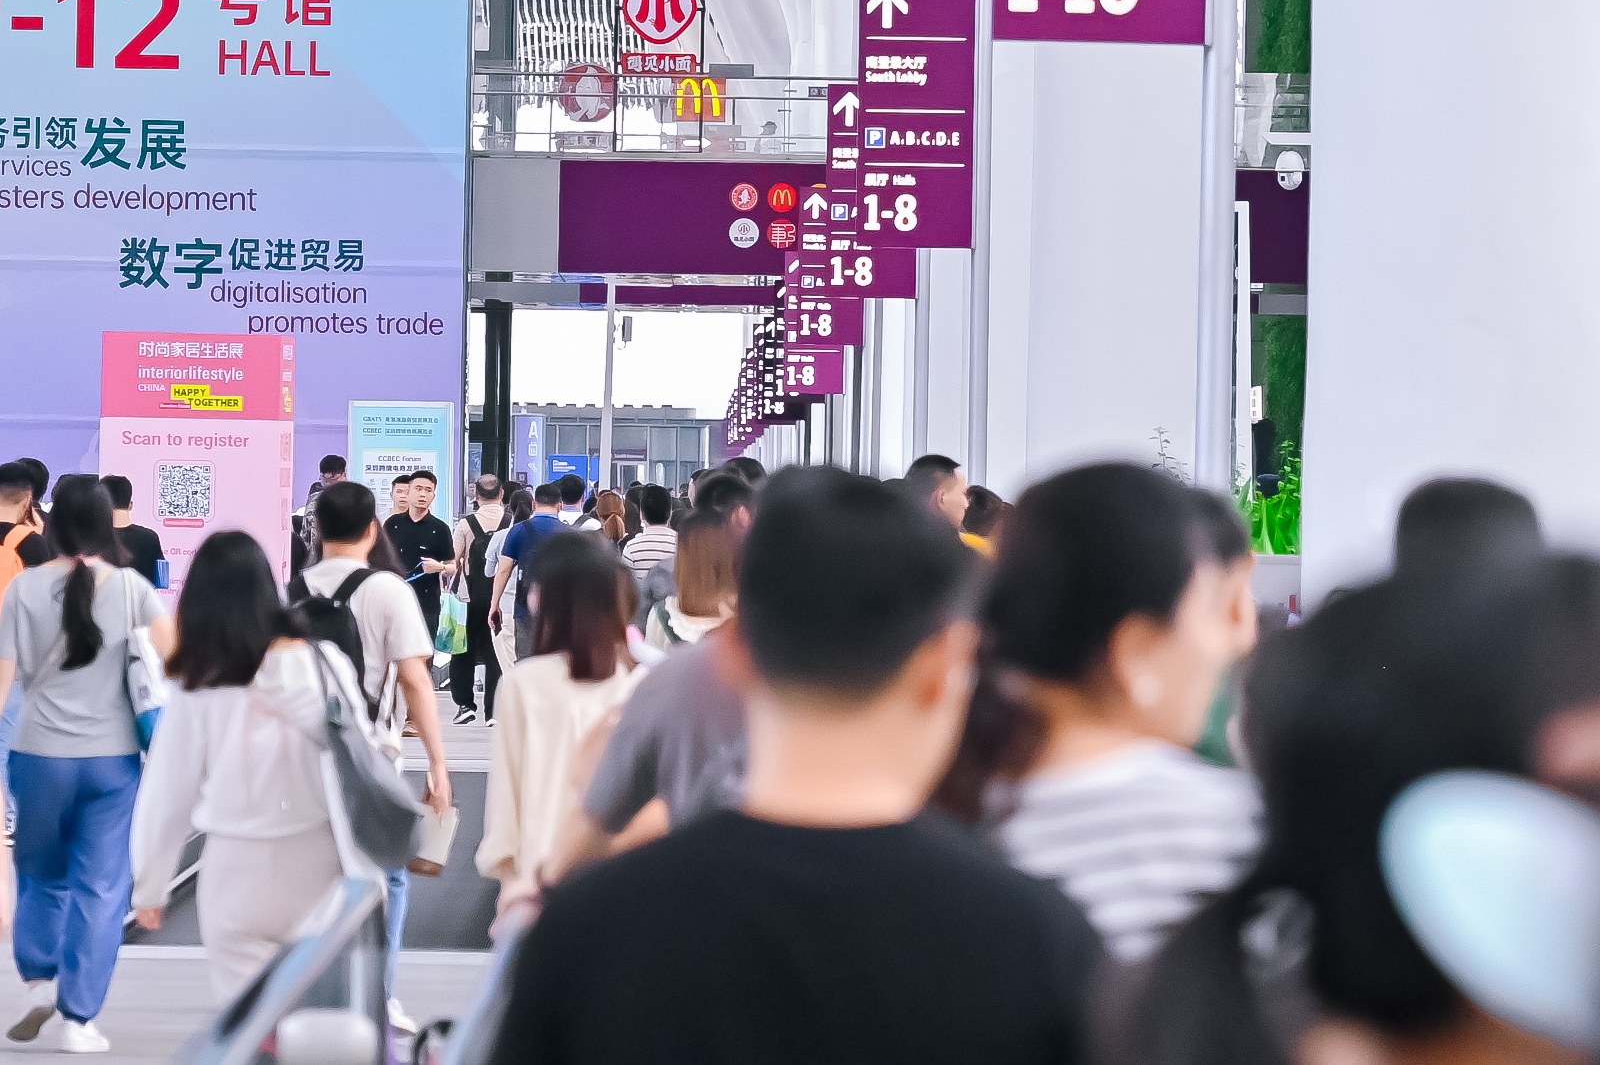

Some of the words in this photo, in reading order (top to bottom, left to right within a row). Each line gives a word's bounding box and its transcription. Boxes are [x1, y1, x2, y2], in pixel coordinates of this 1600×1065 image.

[218, 39, 332, 77] HALL
[72, 184, 258, 217] development
[863, 193, 918, 232] 1-8
[830, 256, 873, 286] 1-8
[210, 279, 368, 306] digitalisation
[247, 310, 368, 337] promotes
[375, 311, 445, 337] trade
[799, 313, 832, 337] 1-8
[139, 340, 244, 360] 时尚家居生活展
[138, 365, 244, 383] interiorlifestyle
[786, 365, 815, 387] 1-8
[138, 383, 166, 392] CHINA
[173, 388, 206, 397] HAPPY
[188, 397, 239, 407] TOGETHER
[122, 430, 162, 446] Scan
[167, 432, 183, 446] to
[188, 433, 250, 450] register
